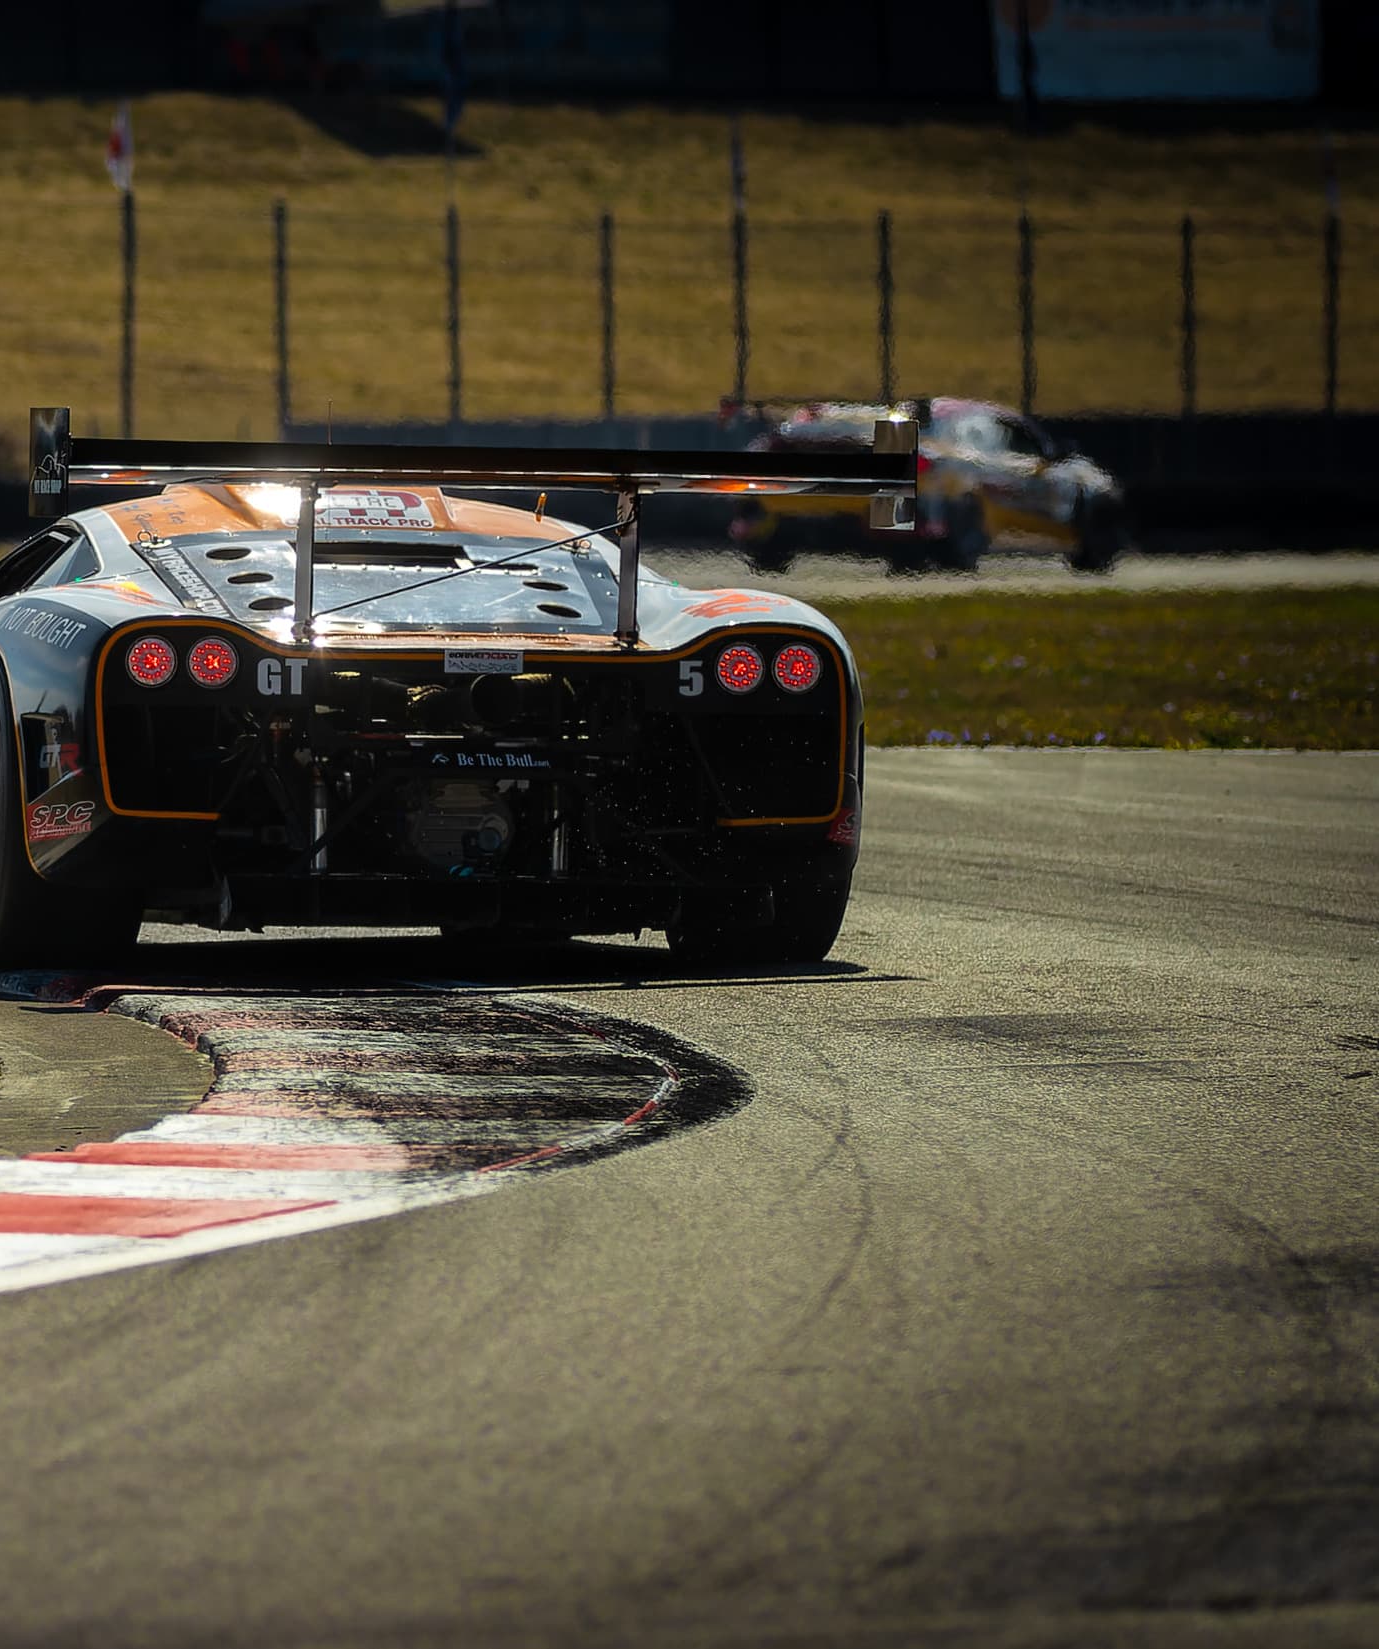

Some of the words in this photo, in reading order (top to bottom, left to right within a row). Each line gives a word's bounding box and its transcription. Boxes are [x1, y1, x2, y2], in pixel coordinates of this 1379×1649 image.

[333, 517, 394, 526] TRACK
[398, 519, 432, 528] PRO
[1, 606, 38, 632] NOT
[23, 611, 88, 649] BOUGHT
[257, 658, 309, 696] GT
[678, 660, 704, 697] 5
[457, 752, 475, 767] Be
[476, 752, 503, 767] The
[29, 800, 96, 829] SPC
